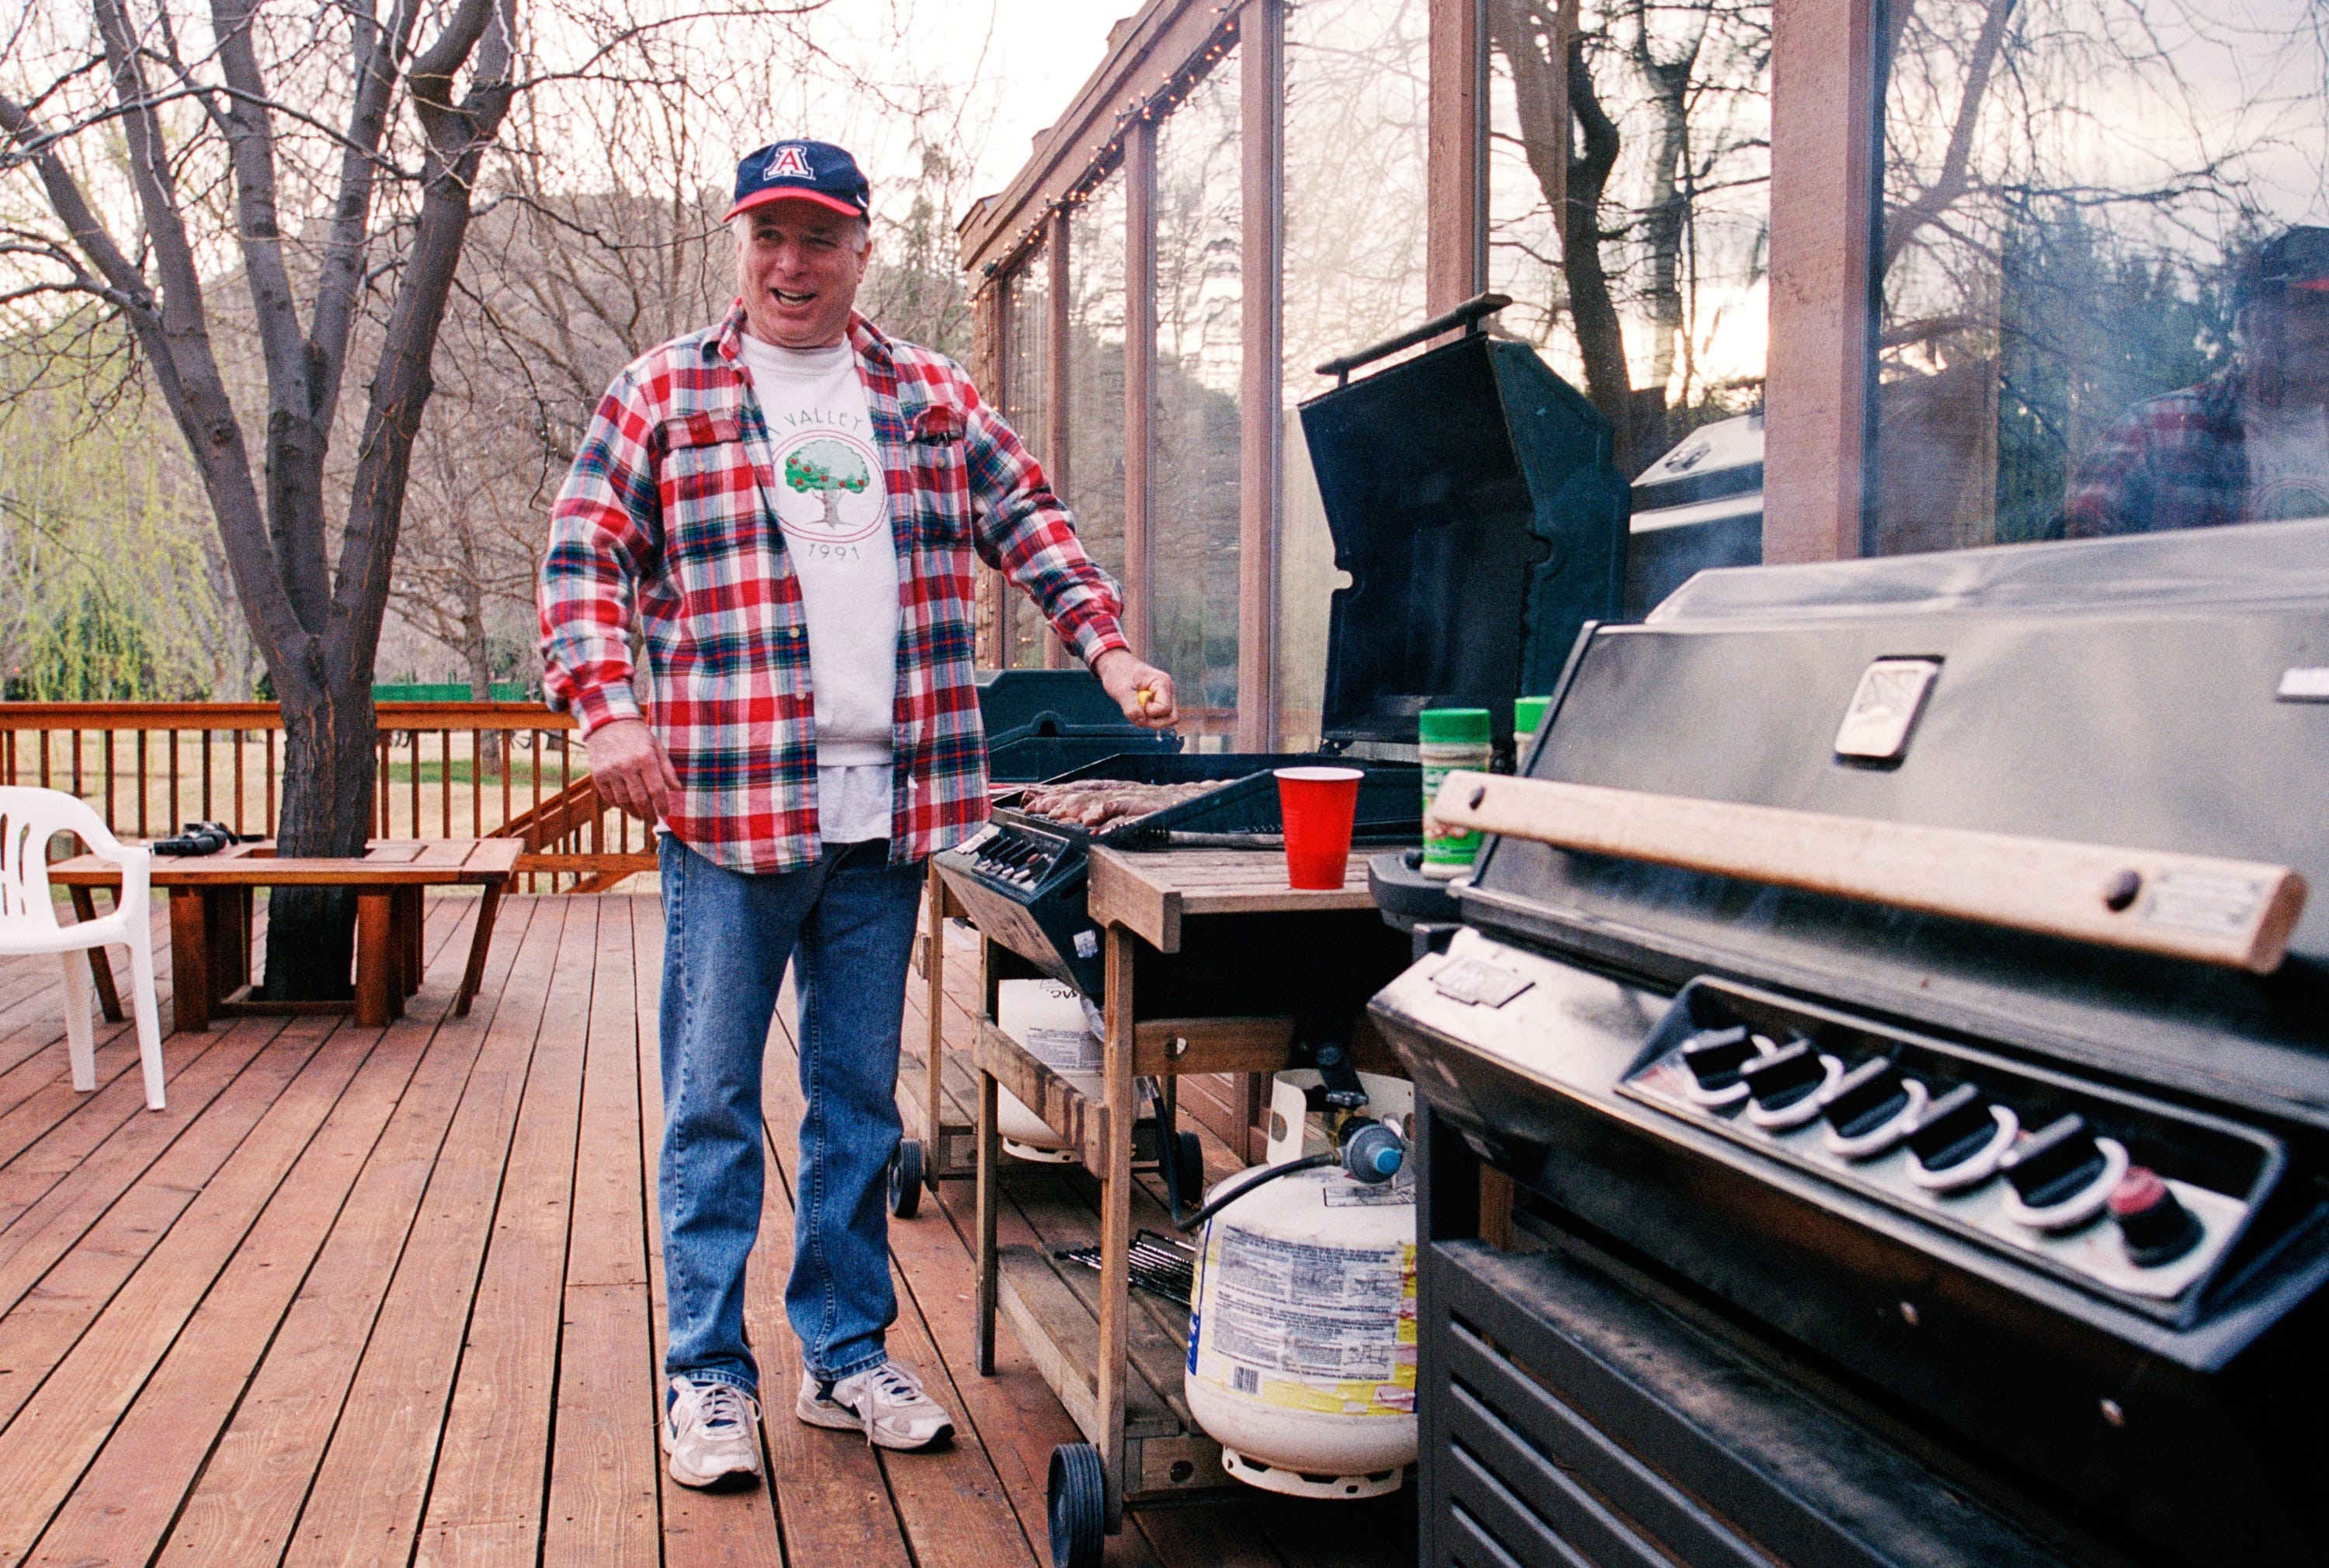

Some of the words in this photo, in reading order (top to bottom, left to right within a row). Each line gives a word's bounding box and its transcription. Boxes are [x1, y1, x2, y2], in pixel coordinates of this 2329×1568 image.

[764, 145, 814, 182] A
[783, 407, 863, 431] VALLEY
[807, 543, 861, 561] 1991
